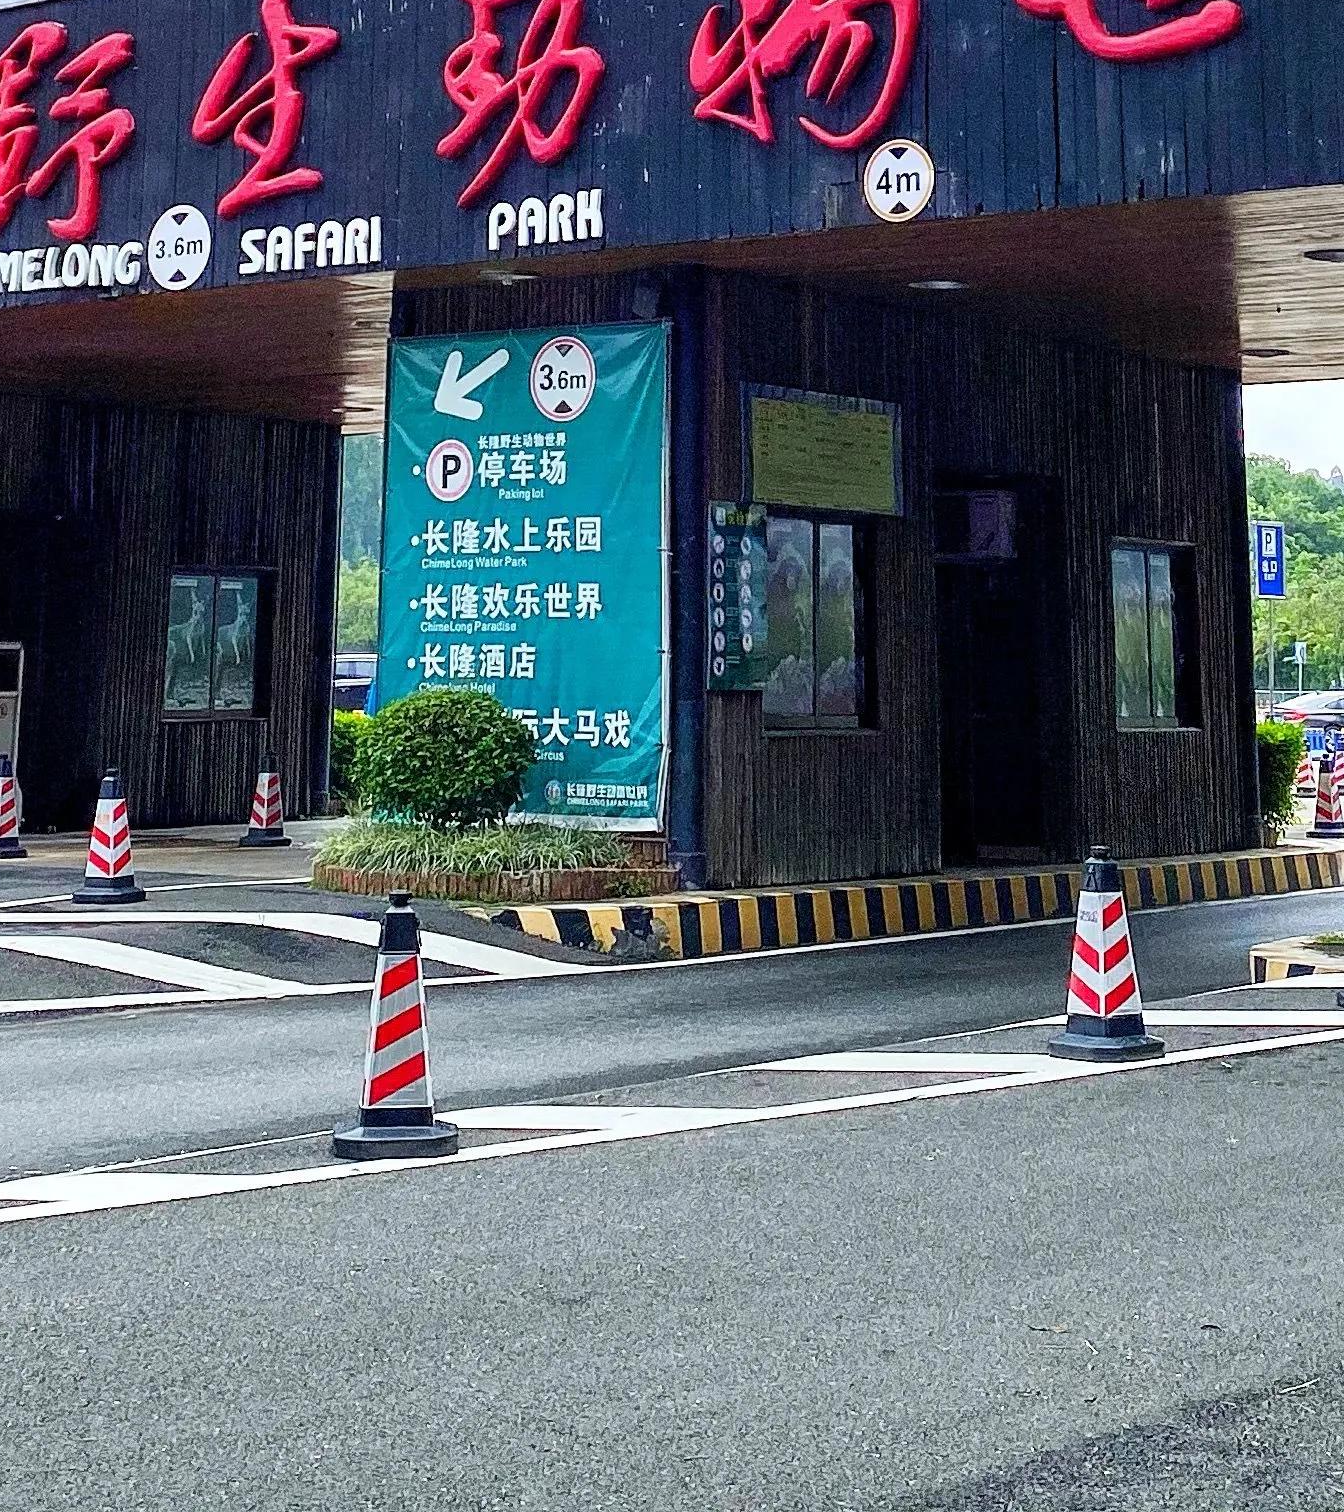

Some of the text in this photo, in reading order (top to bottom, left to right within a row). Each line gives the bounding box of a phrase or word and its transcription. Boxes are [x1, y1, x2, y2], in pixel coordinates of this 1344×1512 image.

[875, 167, 921, 194] 4m
[487, 188, 604, 250] PARK
[155, 235, 204, 259] 3.6m
[238, 216, 382, 274] SAFARI
[539, 364, 586, 391] 3.6m
[478, 432, 567, 450] 长隆野生动物世界
[441, 454, 461, 489] P
[478, 450, 567, 488] 停车场
[422, 516, 602, 556] 长隆水上乐园
[475, 558, 504, 567] Water
[505, 557, 527, 567] Park
[420, 582, 603, 620] 长隆欢乐世界
[419, 642, 536, 680] 长隆酒店
[535, 749, 565, 761] Circus
